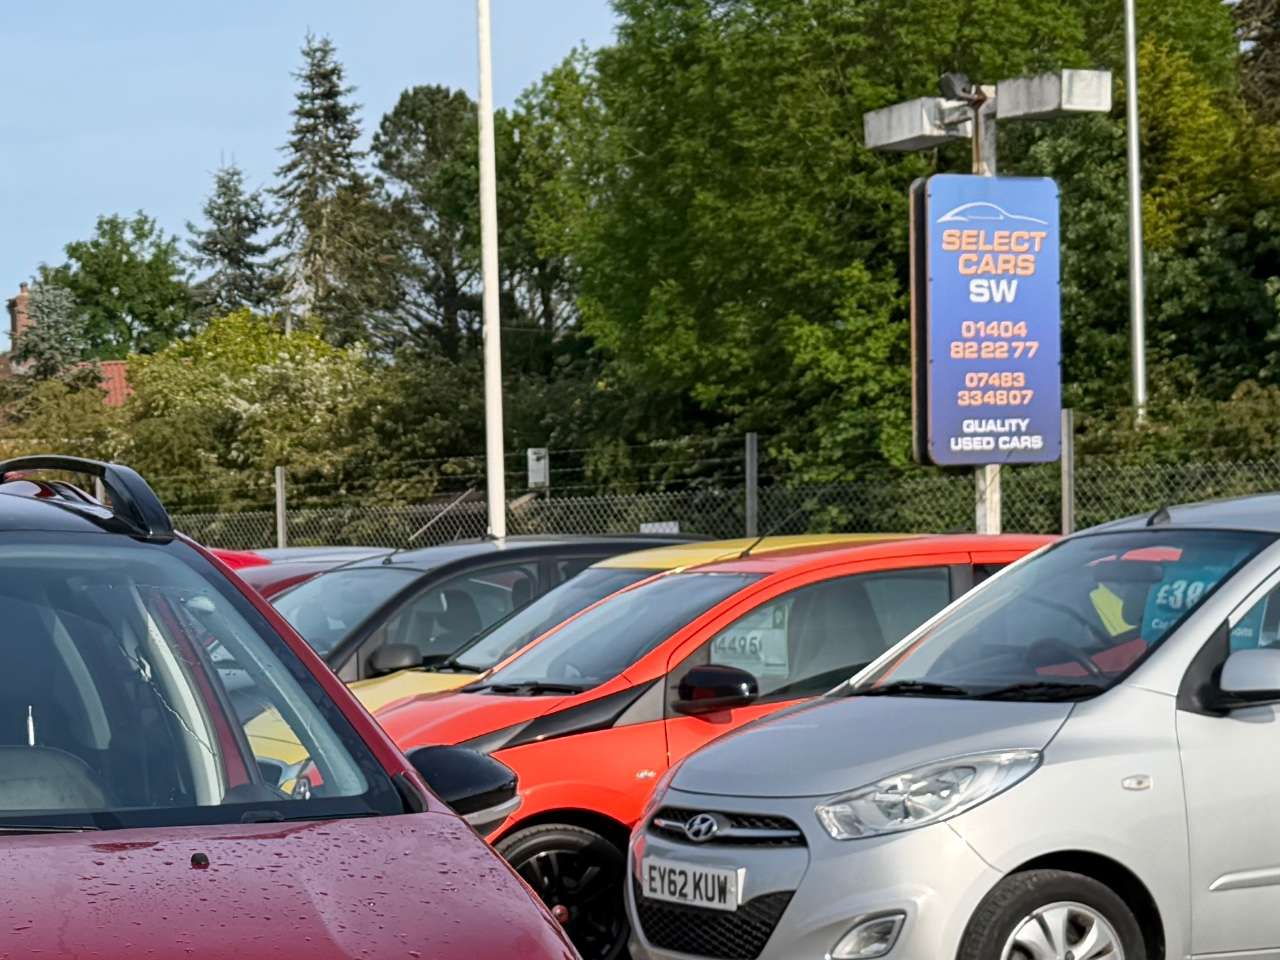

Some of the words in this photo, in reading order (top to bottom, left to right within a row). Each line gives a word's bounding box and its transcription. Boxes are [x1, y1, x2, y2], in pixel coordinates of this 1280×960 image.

[942, 229, 1047, 252] SELECT
[958, 254, 1035, 276] CARS
[969, 279, 1018, 303] SW
[961, 321, 1028, 338] 01404
[965, 372, 1025, 388] 07483
[957, 390, 1034, 406] 334807
[962, 418, 1030, 432] QUALITY
[950, 436, 995, 451] USED
[998, 435, 1043, 450] CARS
[648, 865, 688, 898] EY62
[693, 870, 727, 904] KUW
